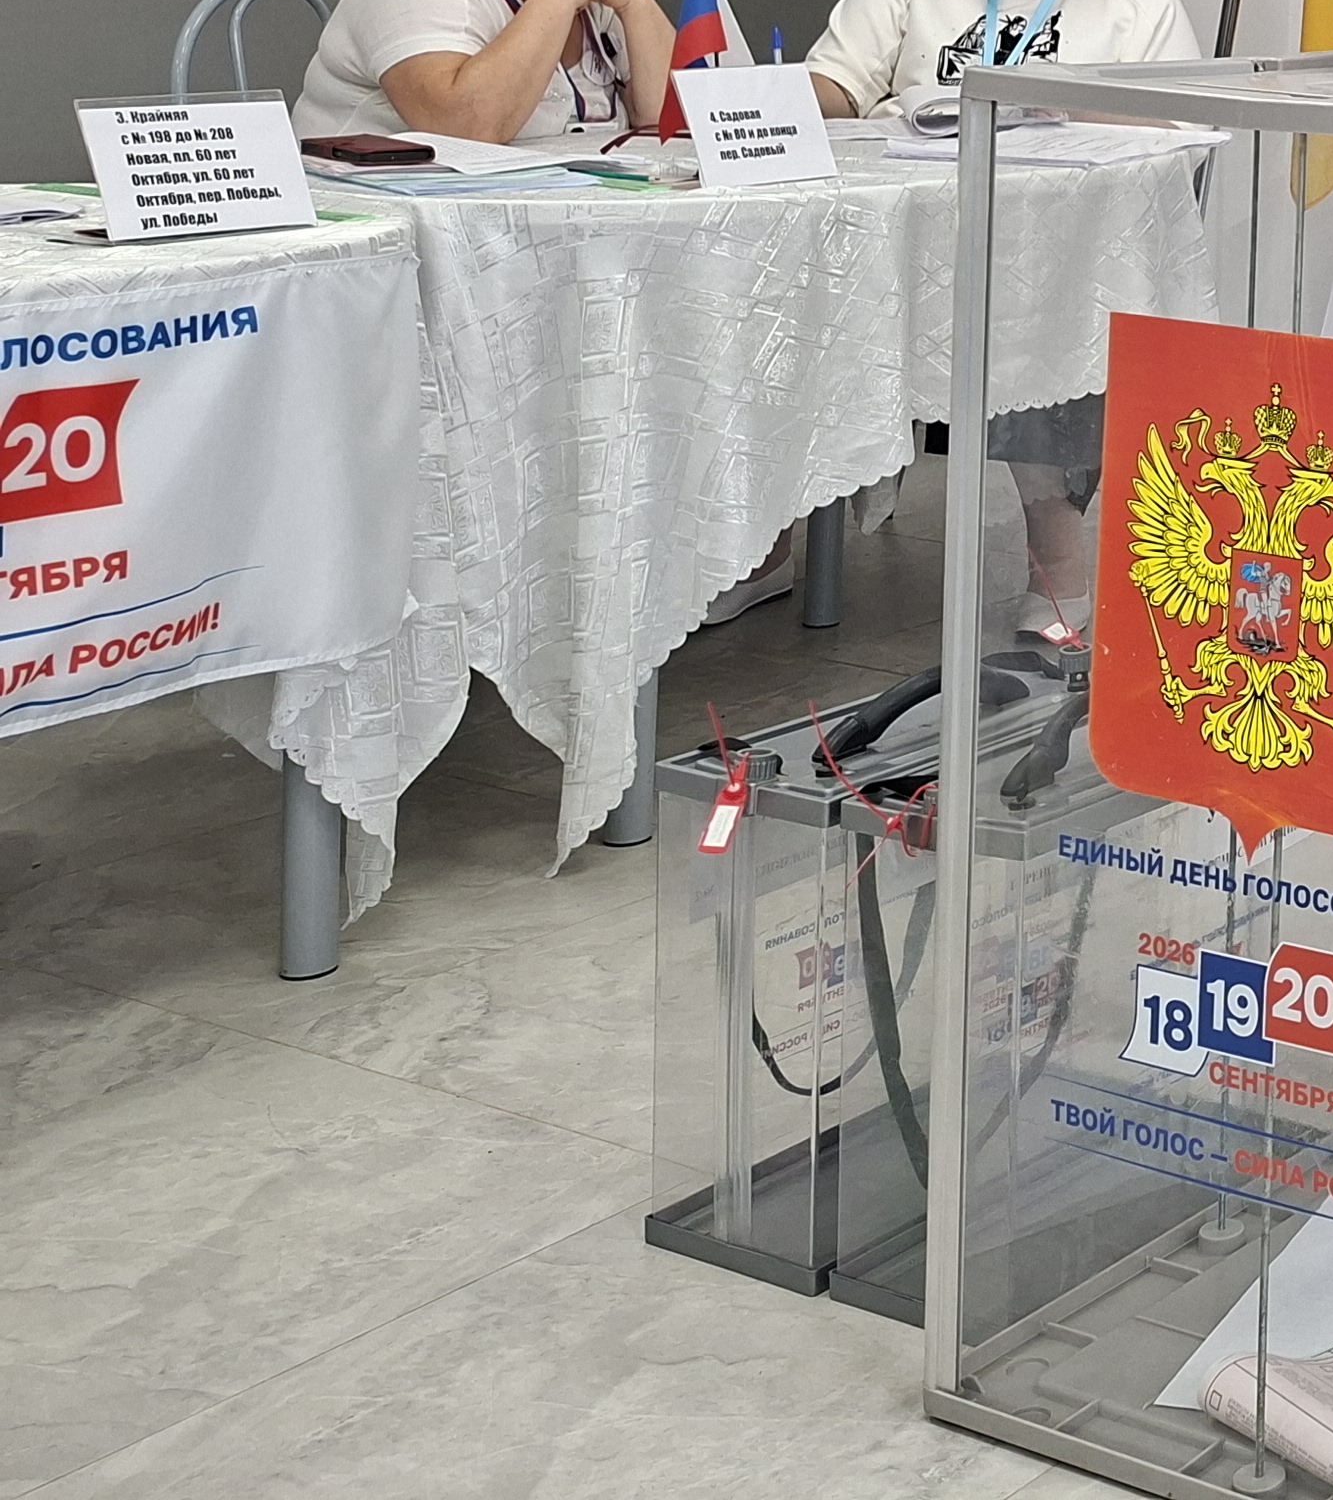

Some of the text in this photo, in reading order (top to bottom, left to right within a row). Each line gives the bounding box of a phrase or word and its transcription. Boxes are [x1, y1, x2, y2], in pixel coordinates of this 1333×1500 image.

[130, 109, 189, 125] Крайняя
[719, 110, 761, 122] Садовая
[121, 127, 234, 145] с № 198 до № 208
[748, 129, 755, 139] и
[757, 127, 769, 140] до
[769, 125, 798, 137] конца
[126, 149, 237, 166] Новая, пл. 60 лет
[720, 142, 786, 160] пер. Садовый
[132, 168, 255, 186] Октября, ул. 60 лет
[136, 186, 282, 207] Октября, пер. Победы,
[141, 212, 218, 230] ул. Победы
[1, 415, 107, 494] 20
[68, 602, 220, 674] РОССИИ!
[1058, 834, 1164, 878] ЕДИНЫЙ
[1169, 858, 1237, 894] ДЕНЬ
[1137, 933, 1196, 966] 2026
[1143, 995, 1193, 1051] 18
[1206, 978, 1259, 1037] 19
[1050, 1099, 1116, 1139] ТВОЙ
[1122, 1119, 1205, 1162] ГОЛОС
[1233, 1149, 1305, 1189] СИЛА
